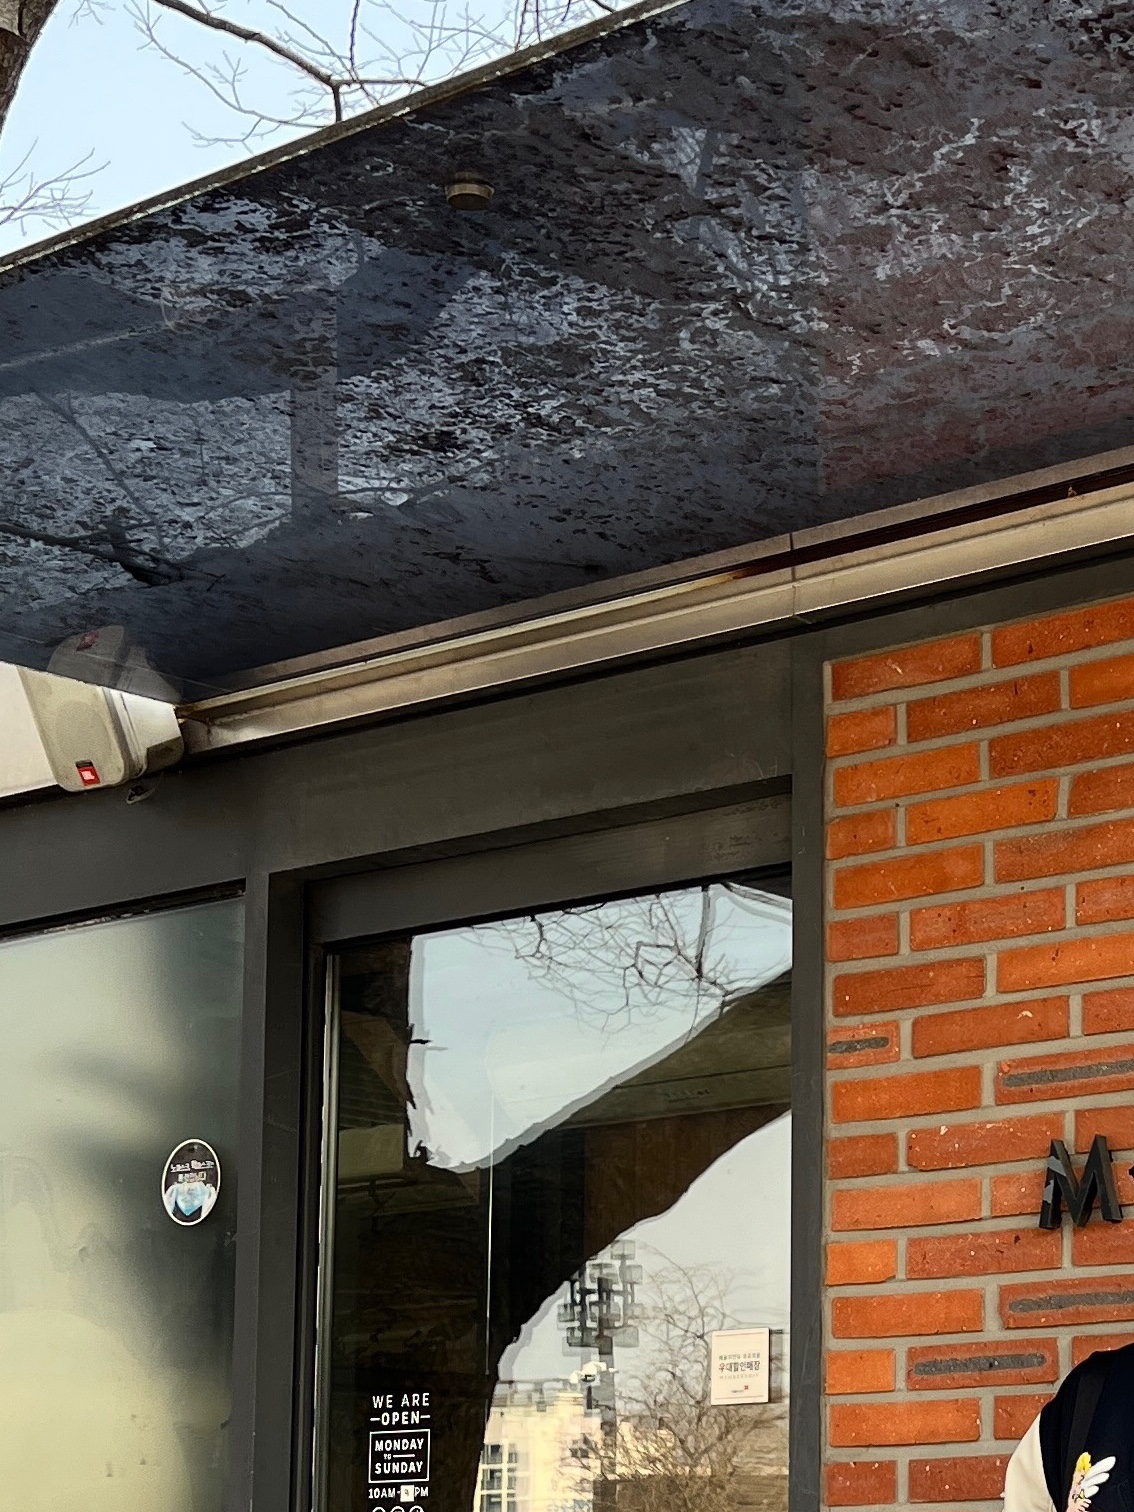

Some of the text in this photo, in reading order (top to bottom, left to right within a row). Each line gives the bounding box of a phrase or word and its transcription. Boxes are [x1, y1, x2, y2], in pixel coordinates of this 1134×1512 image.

[372, 1393, 430, 1408] WE ARE
[374, 1438, 424, 1452] MONDAY
[374, 1461, 423, 1474] SUNDAY
